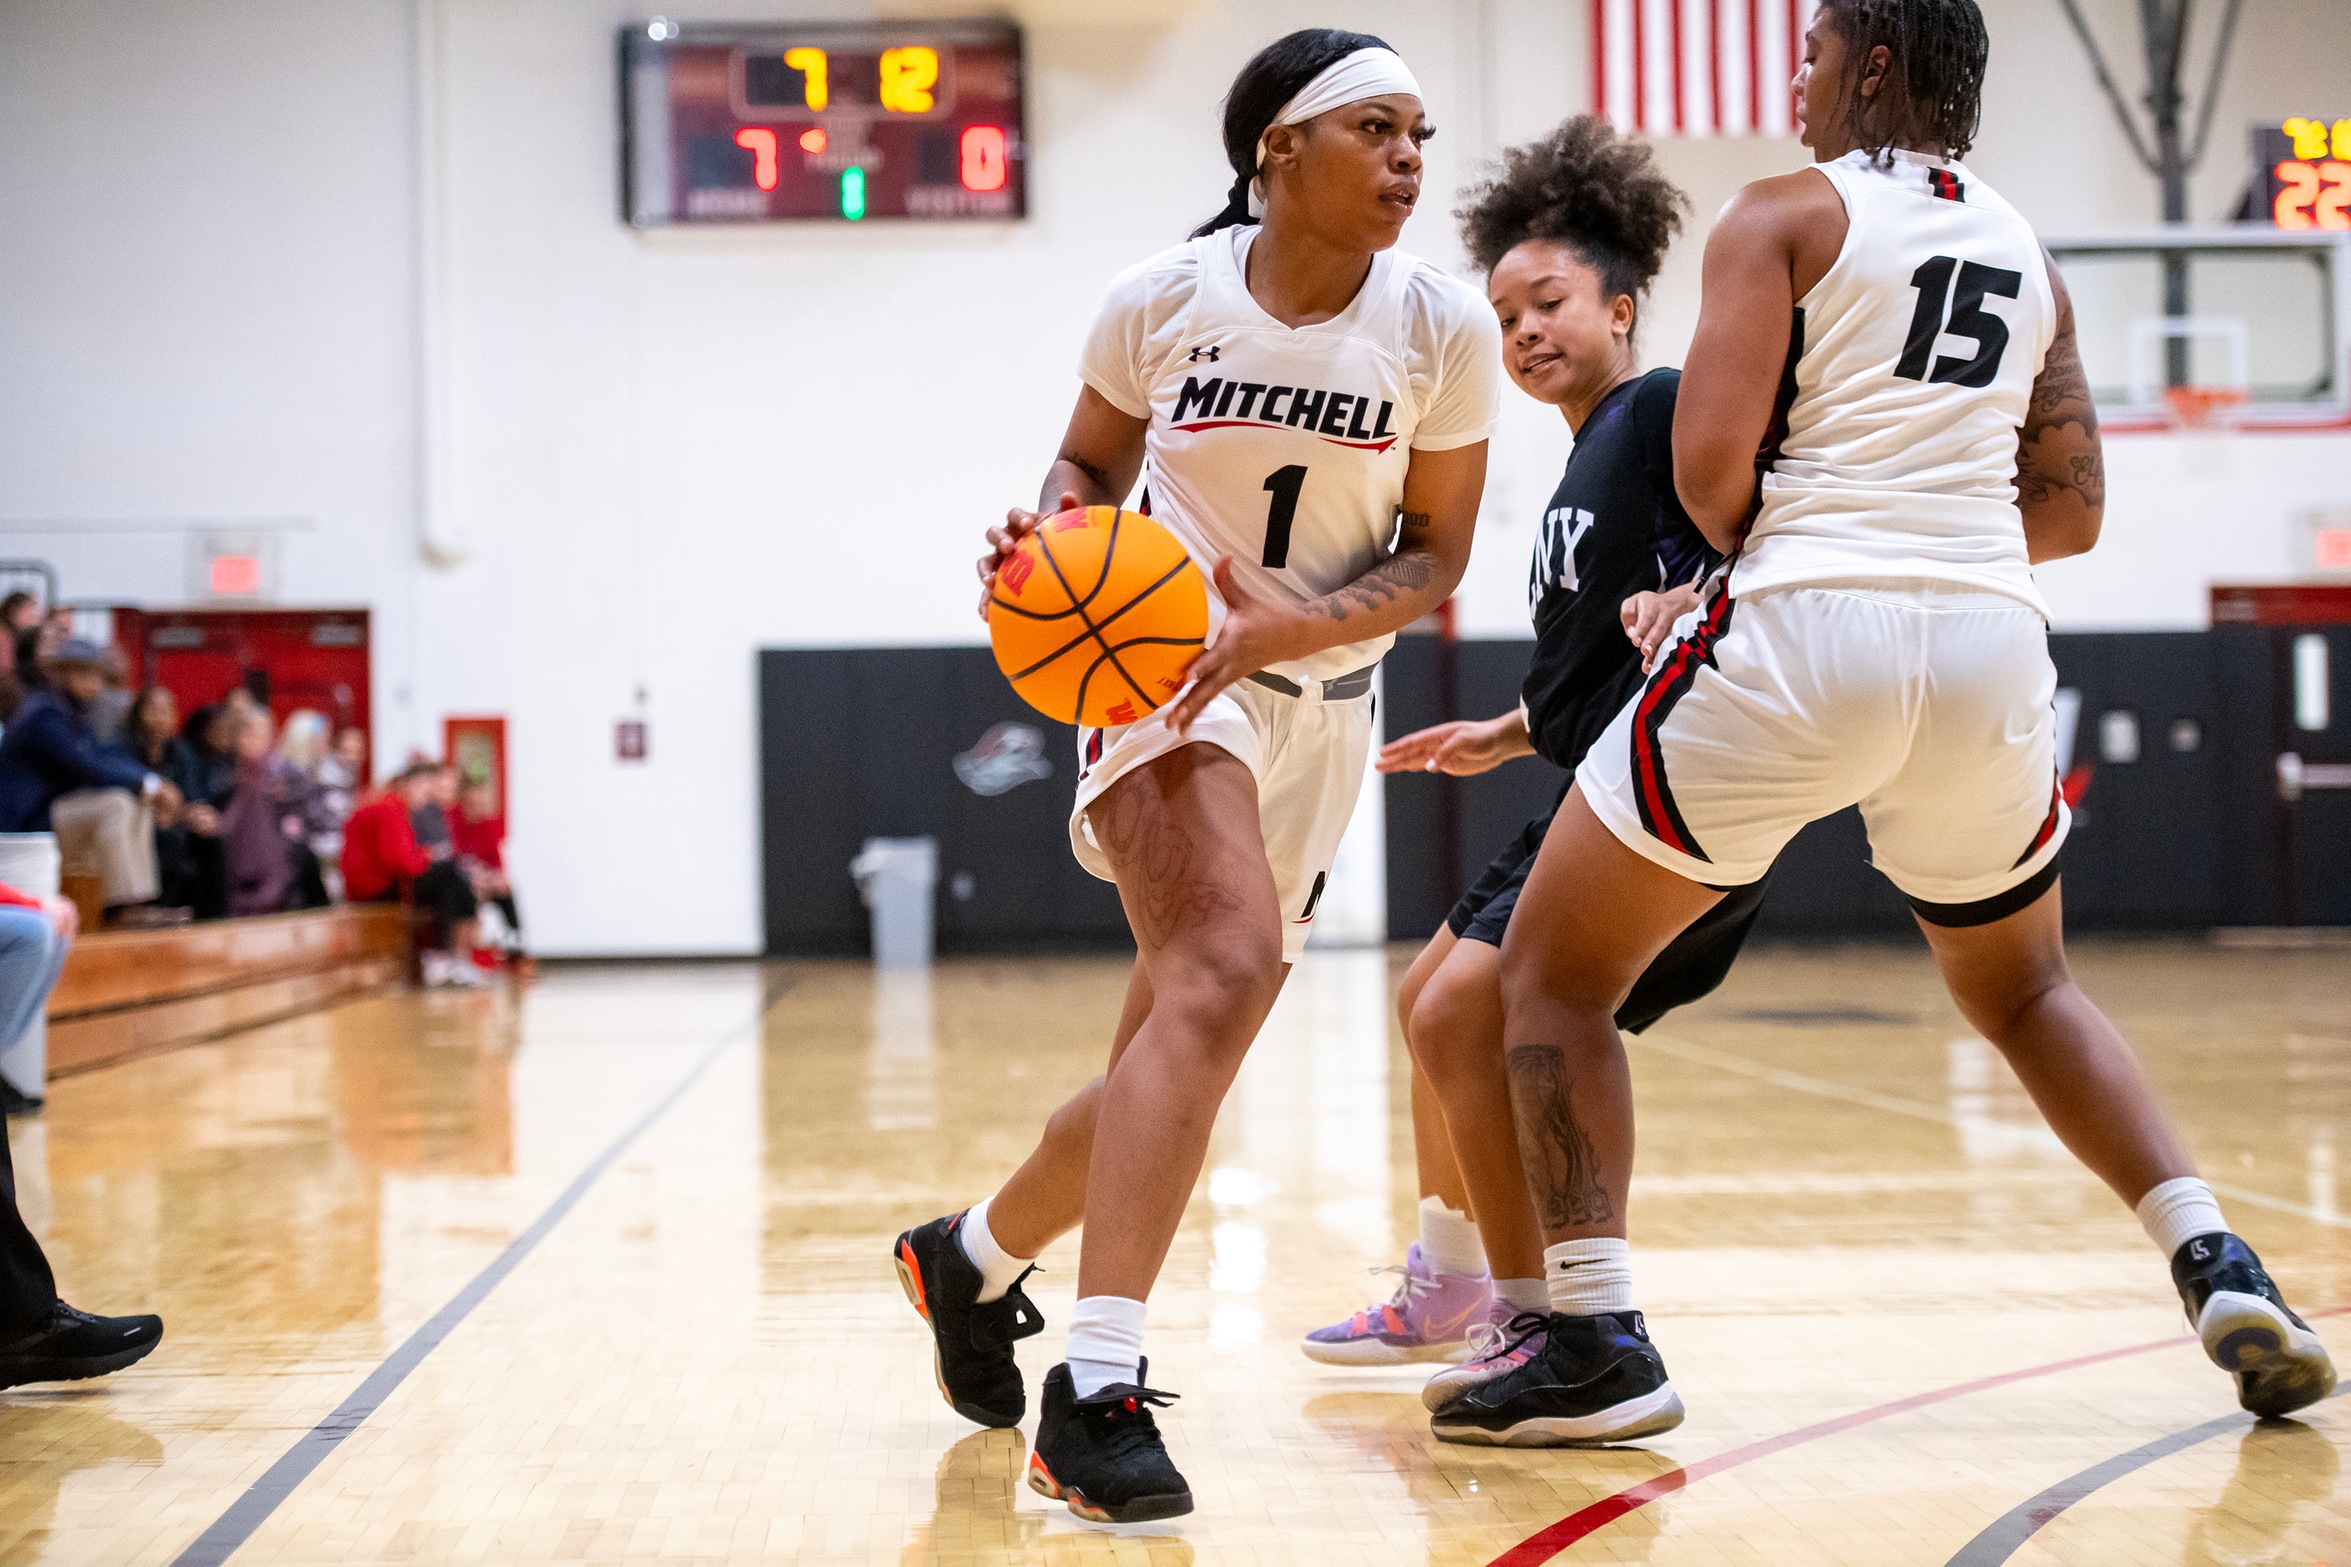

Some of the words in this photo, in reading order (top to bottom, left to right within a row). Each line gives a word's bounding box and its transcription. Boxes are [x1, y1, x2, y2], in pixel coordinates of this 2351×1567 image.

[734, 127, 778, 192] 7
[960, 125, 1006, 191] 0
[1893, 256, 2023, 388] 15
[1171, 376, 1397, 440] MITCHELL
[1263, 464, 1309, 569] 1
[1530, 507, 1595, 620] NY
